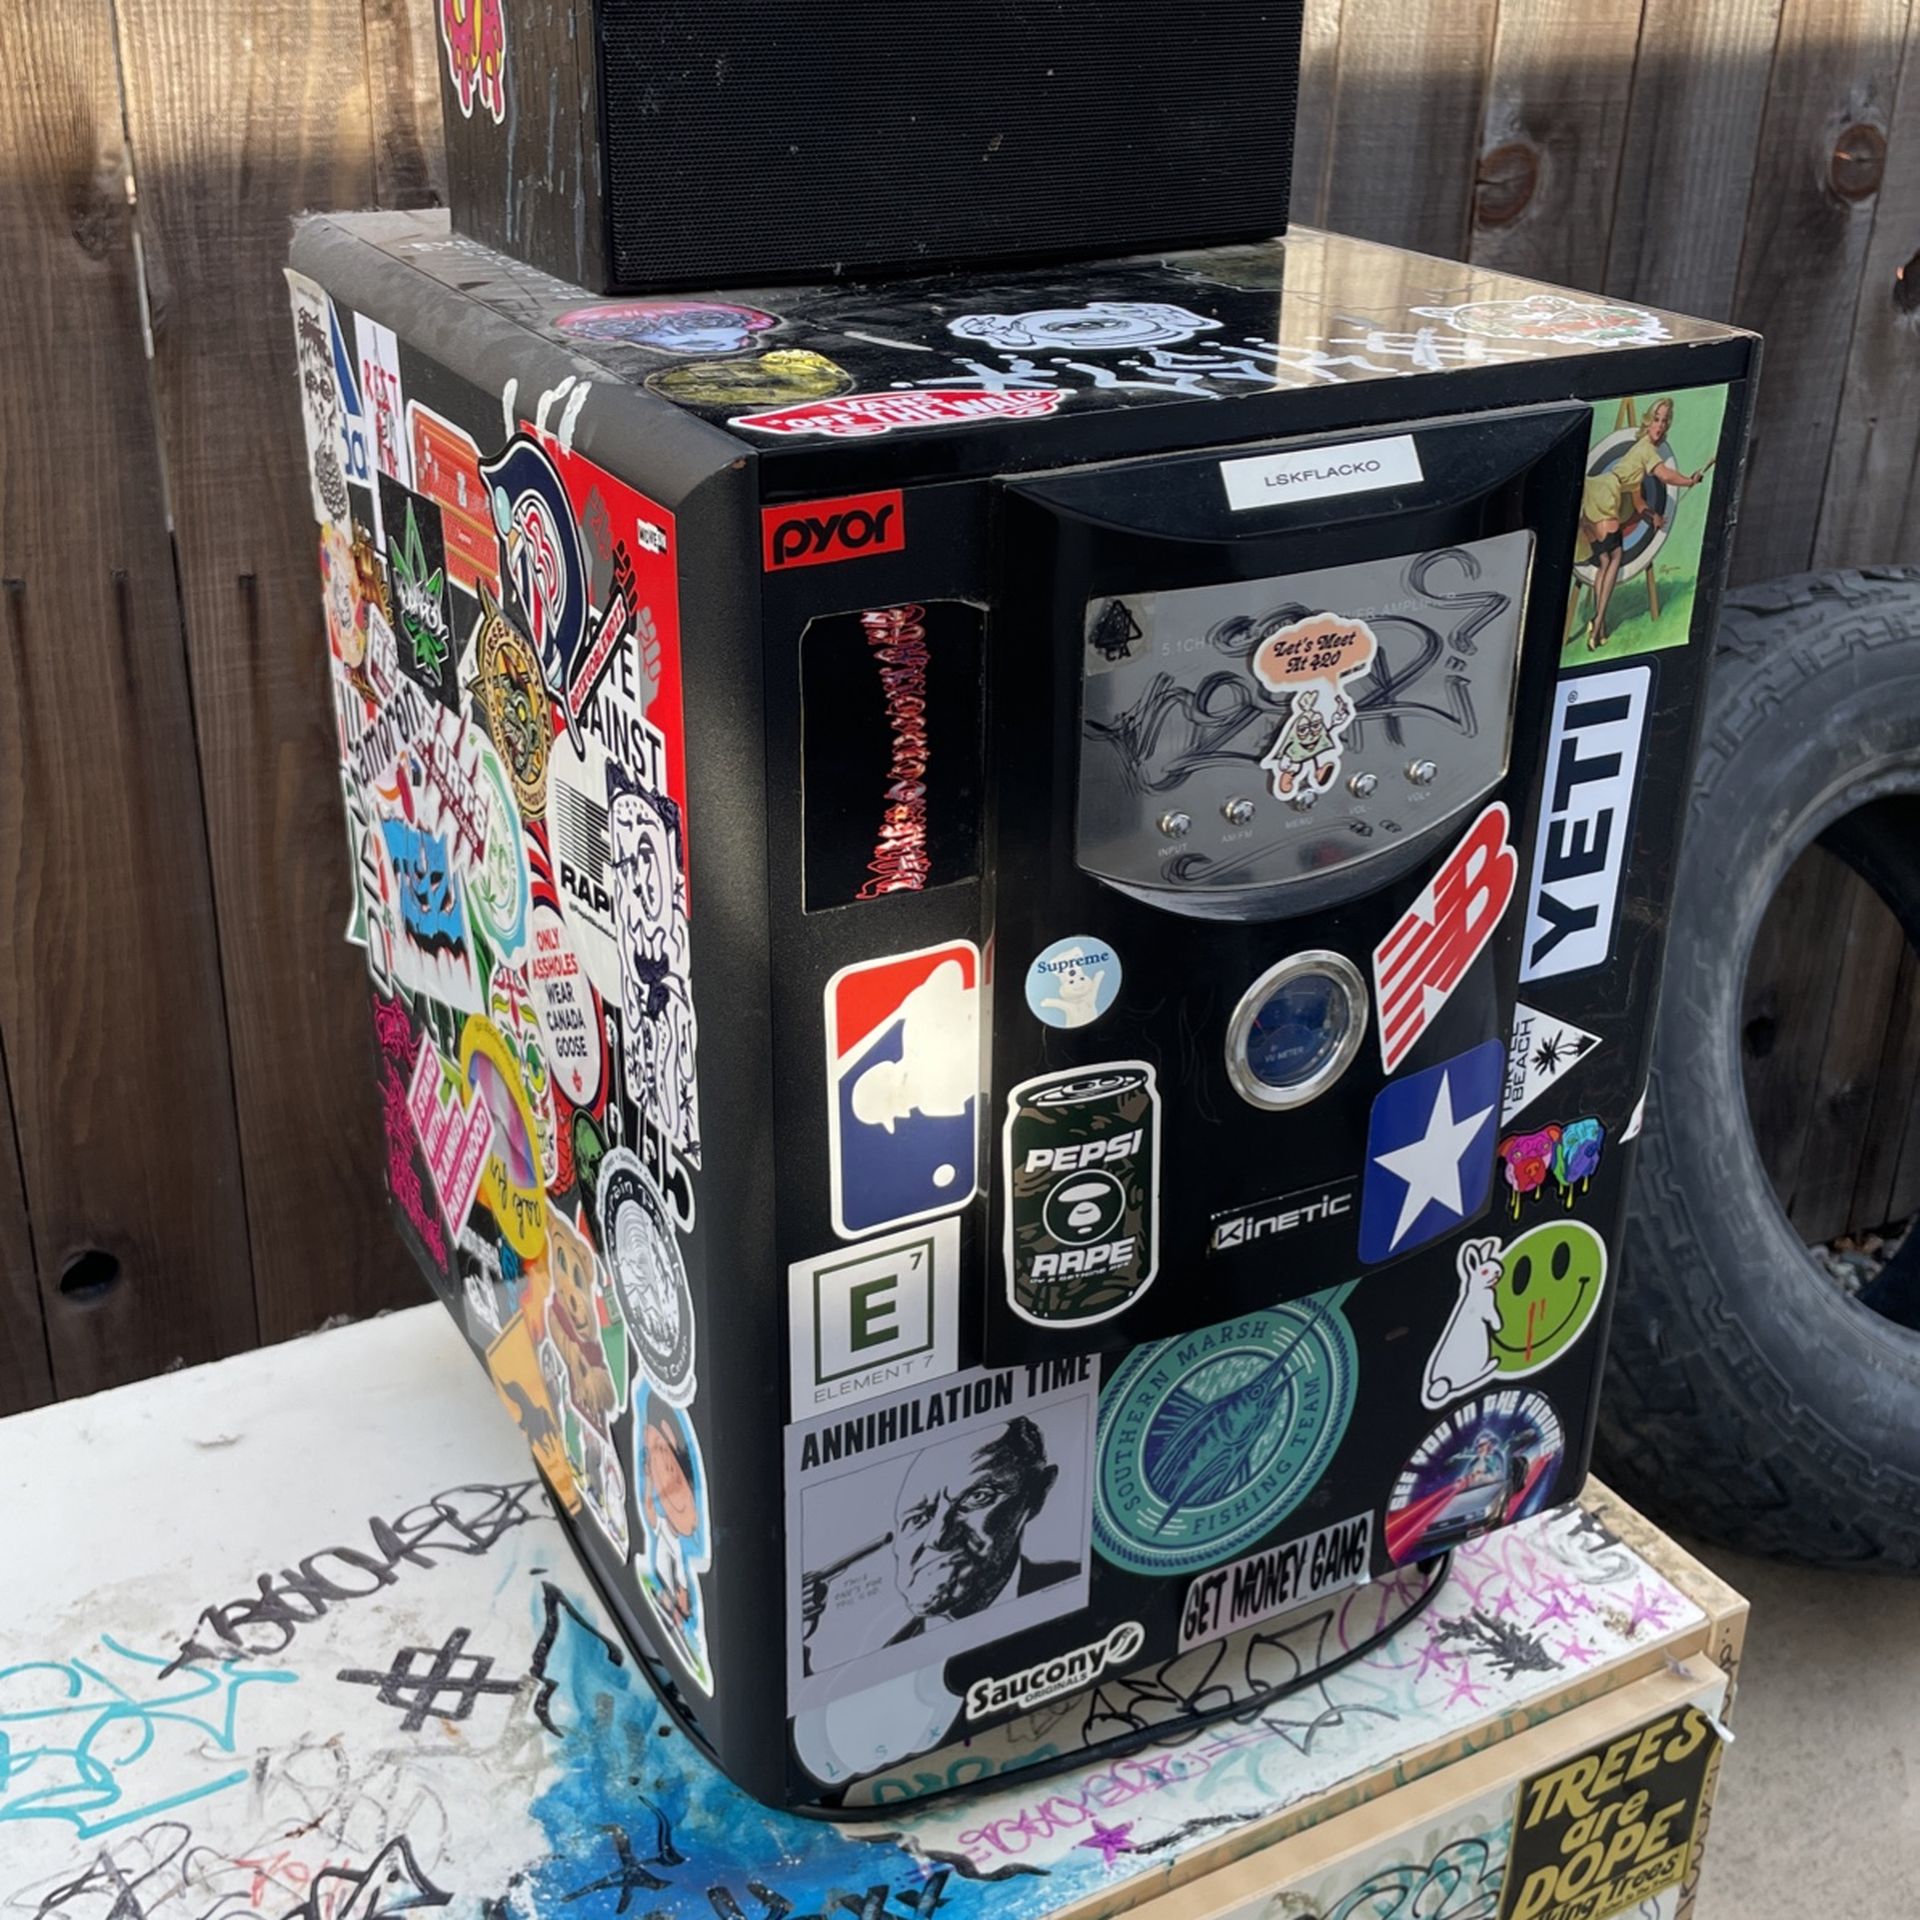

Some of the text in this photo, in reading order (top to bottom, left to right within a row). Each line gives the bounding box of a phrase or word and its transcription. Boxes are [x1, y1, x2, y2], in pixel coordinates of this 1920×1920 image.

[1264, 459, 1381, 488] LSKFLACKO
[773, 504, 894, 565] pyor
[1273, 631, 1356, 657] Let's Meet
[1286, 657, 1308, 673] At
[1309, 650, 1342, 671] 420
[1157, 842, 1189, 858] INPUT
[1530, 694, 1632, 969] YETI
[532, 952, 579, 979] ASSHOLES
[536, 927, 560, 949] ONLY
[1037, 949, 1109, 974] Supreme
[545, 981, 575, 1005] WEAR
[546, 1006, 586, 1031] CANADA
[555, 1034, 587, 1058] GOOSE
[1511, 1017, 1536, 1103] BEACH
[418, 1050, 438, 1119] STAND
[424, 1100, 446, 1161] WITH
[435, 1108, 465, 1193] PLANNED
[1025, 1128, 1143, 1173] PEPSI
[446, 1104, 489, 1225] PARENTHOOD
[909, 1251, 923, 1271] 7
[1031, 1236, 1136, 1278] AAPE
[850, 1274, 899, 1352] E
[814, 1354, 935, 1404] ELEMENT 7
[800, 1349, 1092, 1472] ANNIHILATION TIME
[1114, 1320, 1321, 1512] SOUTHERN MARSH TEAM
[1389, 1471, 1419, 1512] SEE
[1410, 1421, 1453, 1466] YOU
[1454, 1402, 1478, 1430] IN
[1483, 1389, 1522, 1418] THE
[1191, 1458, 1293, 1536] FISHING
[1184, 1517, 1368, 1641] GET MONEY GANG
[974, 1644, 1107, 1714] Saucony
[1026, 1672, 1088, 1703] ORIGINALS
[1524, 1709, 1706, 1830] TREES
[1560, 1789, 1649, 1854] are
[1509, 1798, 1687, 1920] DOPE
[1606, 1856, 1677, 1902] Trees
